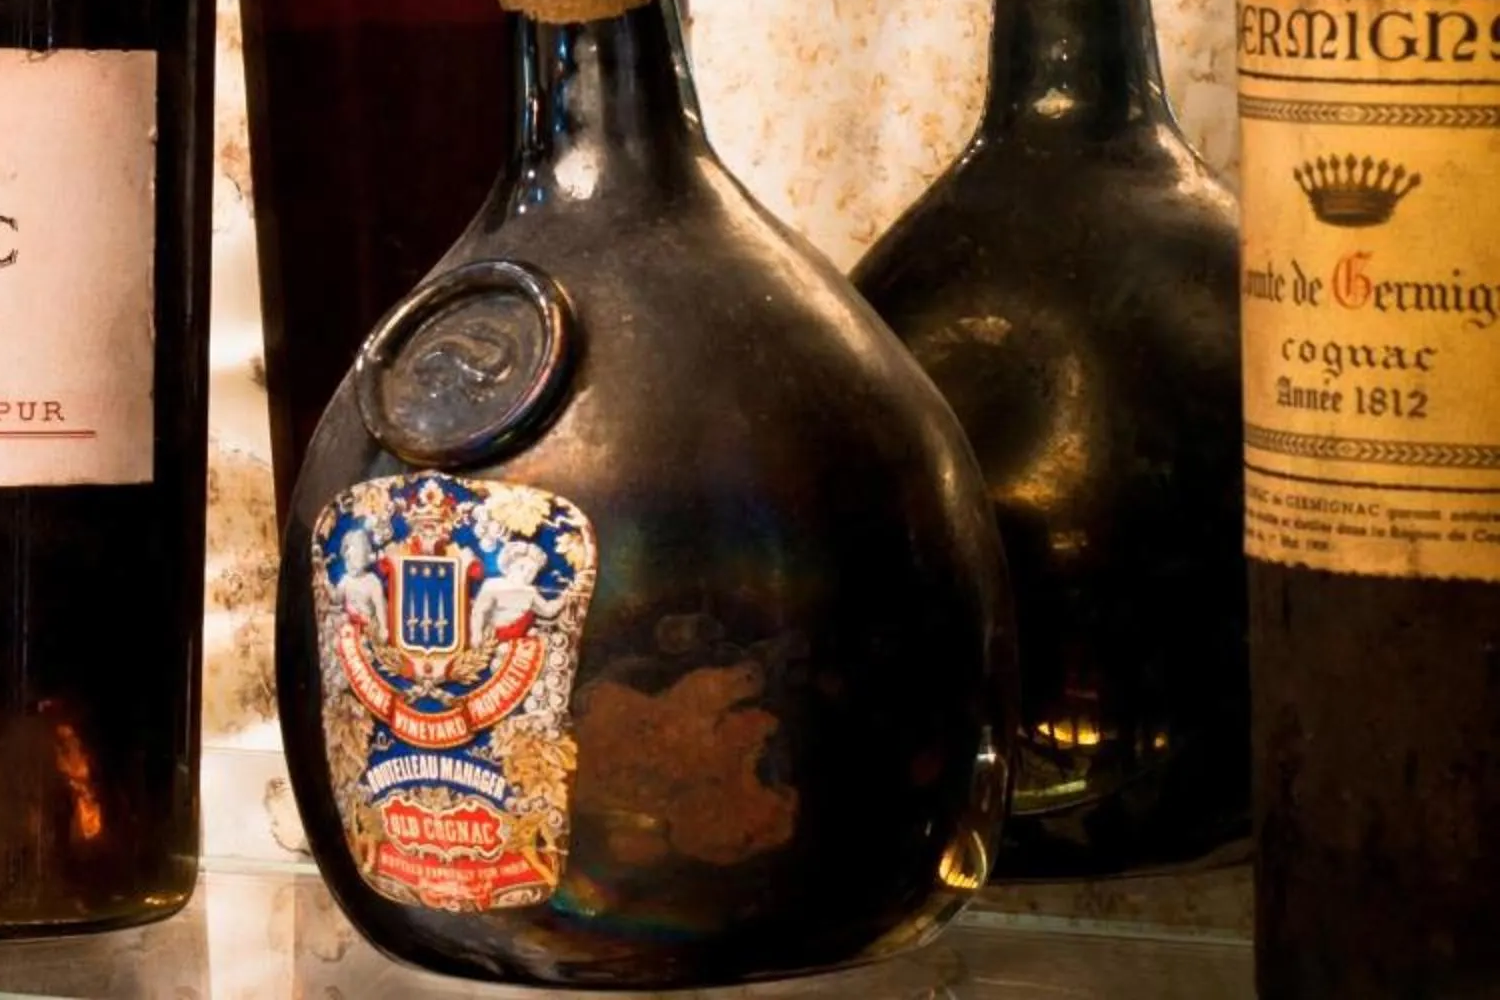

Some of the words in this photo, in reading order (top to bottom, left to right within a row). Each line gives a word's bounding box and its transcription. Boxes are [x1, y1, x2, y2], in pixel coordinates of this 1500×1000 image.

[1237, 3, 1500, 62] ERMIGN
[1291, 258, 1323, 307] de
[1332, 251, 1500, 329] Germig
[1281, 337, 1438, 378] cognac
[1355, 385, 1429, 419] 1812
[394, 711, 467, 740] VINEYARD
[440, 755, 506, 800] MANAGER
[423, 816, 495, 845] COGNAC
